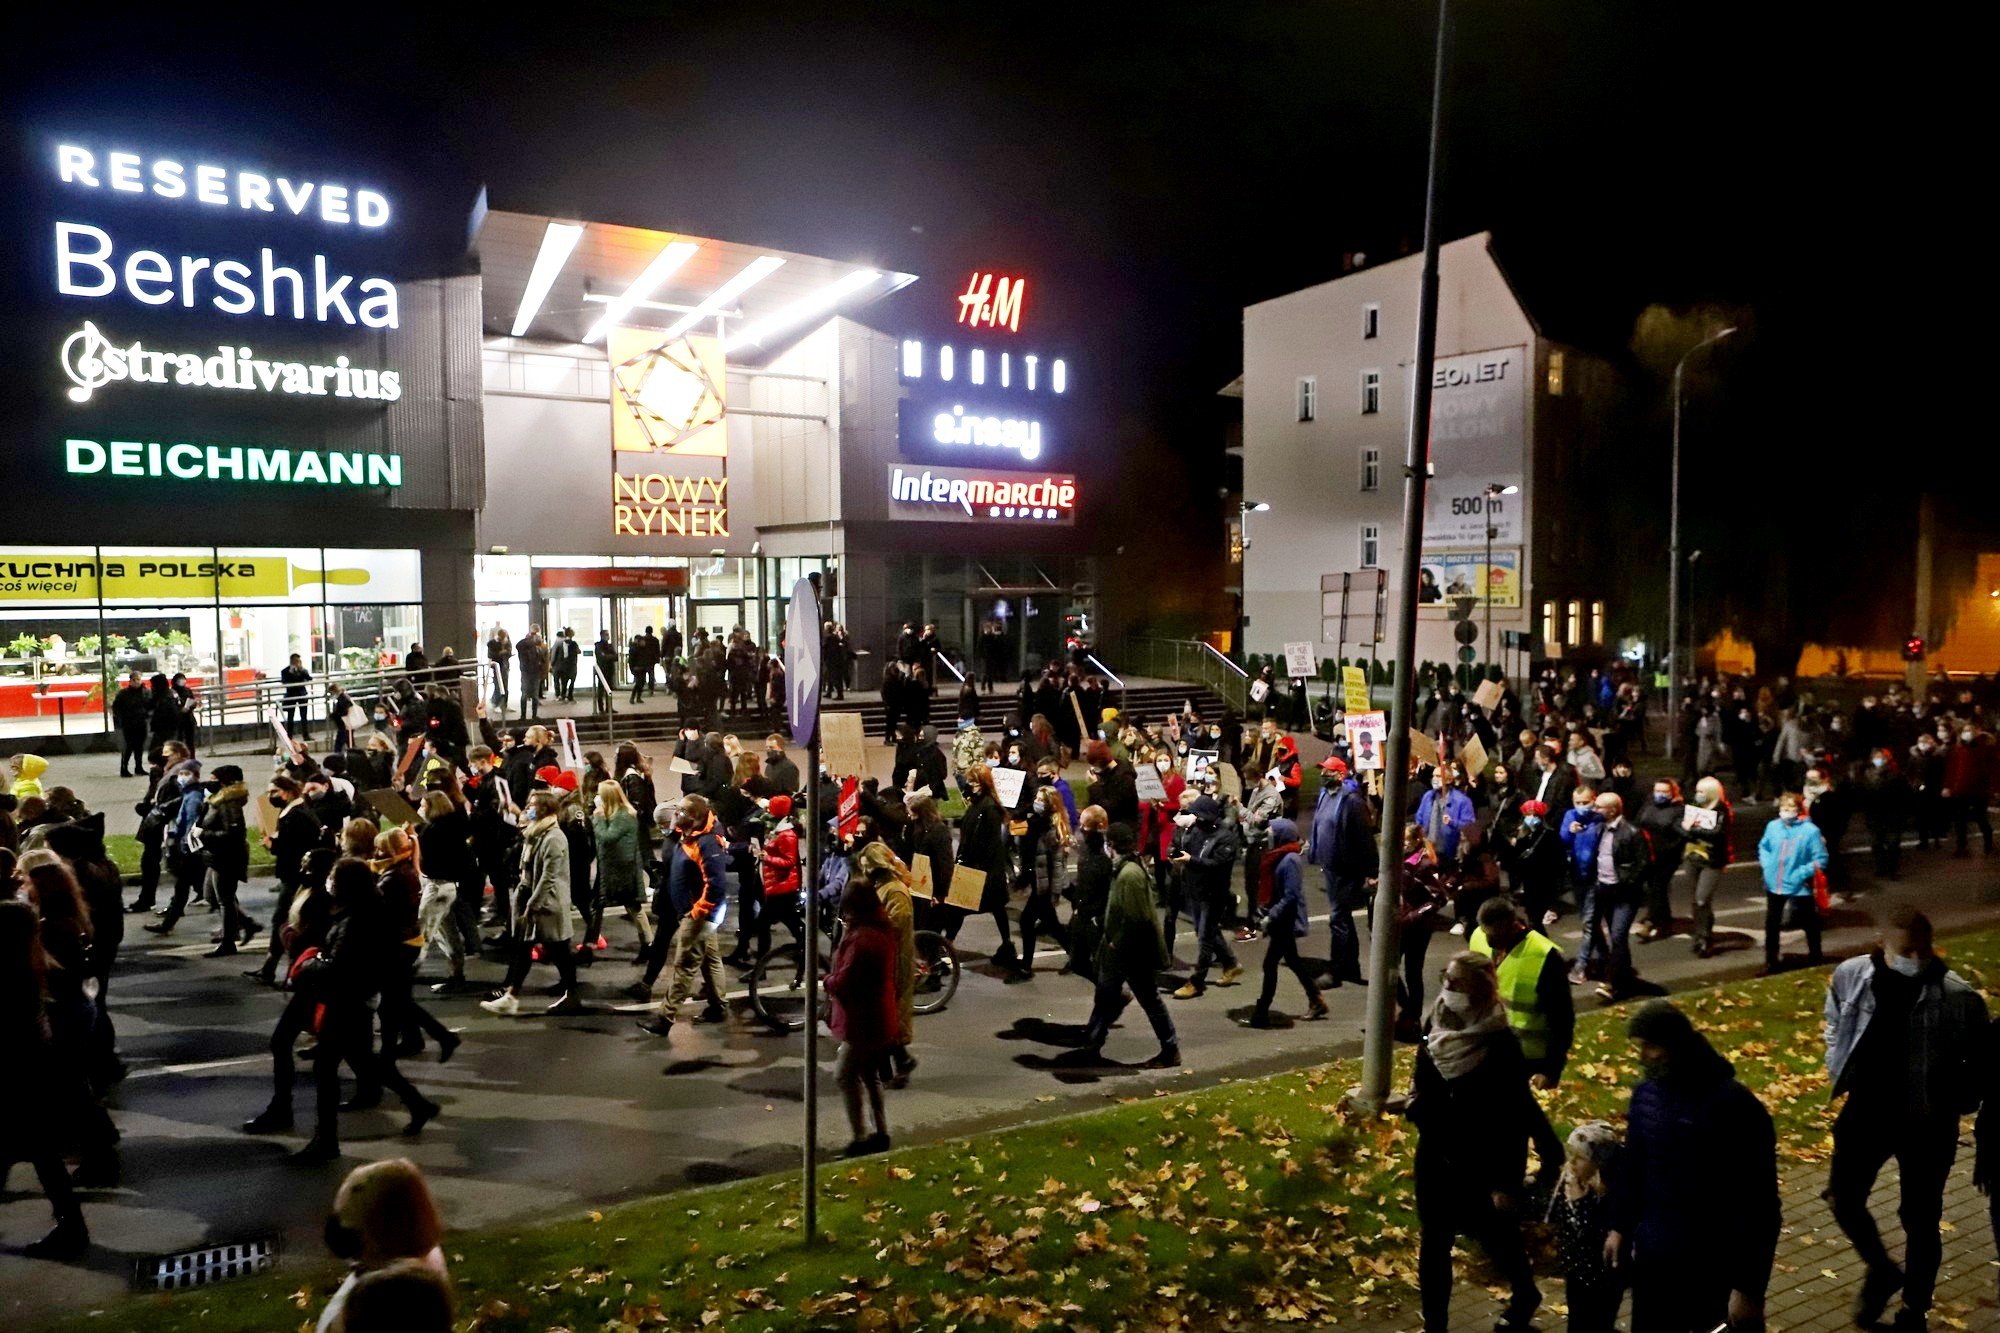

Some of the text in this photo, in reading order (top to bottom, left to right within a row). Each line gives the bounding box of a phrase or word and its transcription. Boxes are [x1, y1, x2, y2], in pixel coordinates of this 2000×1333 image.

[58, 143, 391, 228] RESERVED
[55, 221, 400, 330] Bershka
[958, 271, 1025, 333] H&M
[1433, 357, 1510, 389] EONET
[65, 439, 402, 486] DEICHMANN
[613, 472, 729, 505] NOWY
[614, 505, 730, 537] RYNEK
[989, 506, 1058, 519] SUPER
[1451, 496, 1482, 515] 500
[27, 580, 78, 593] więcej
